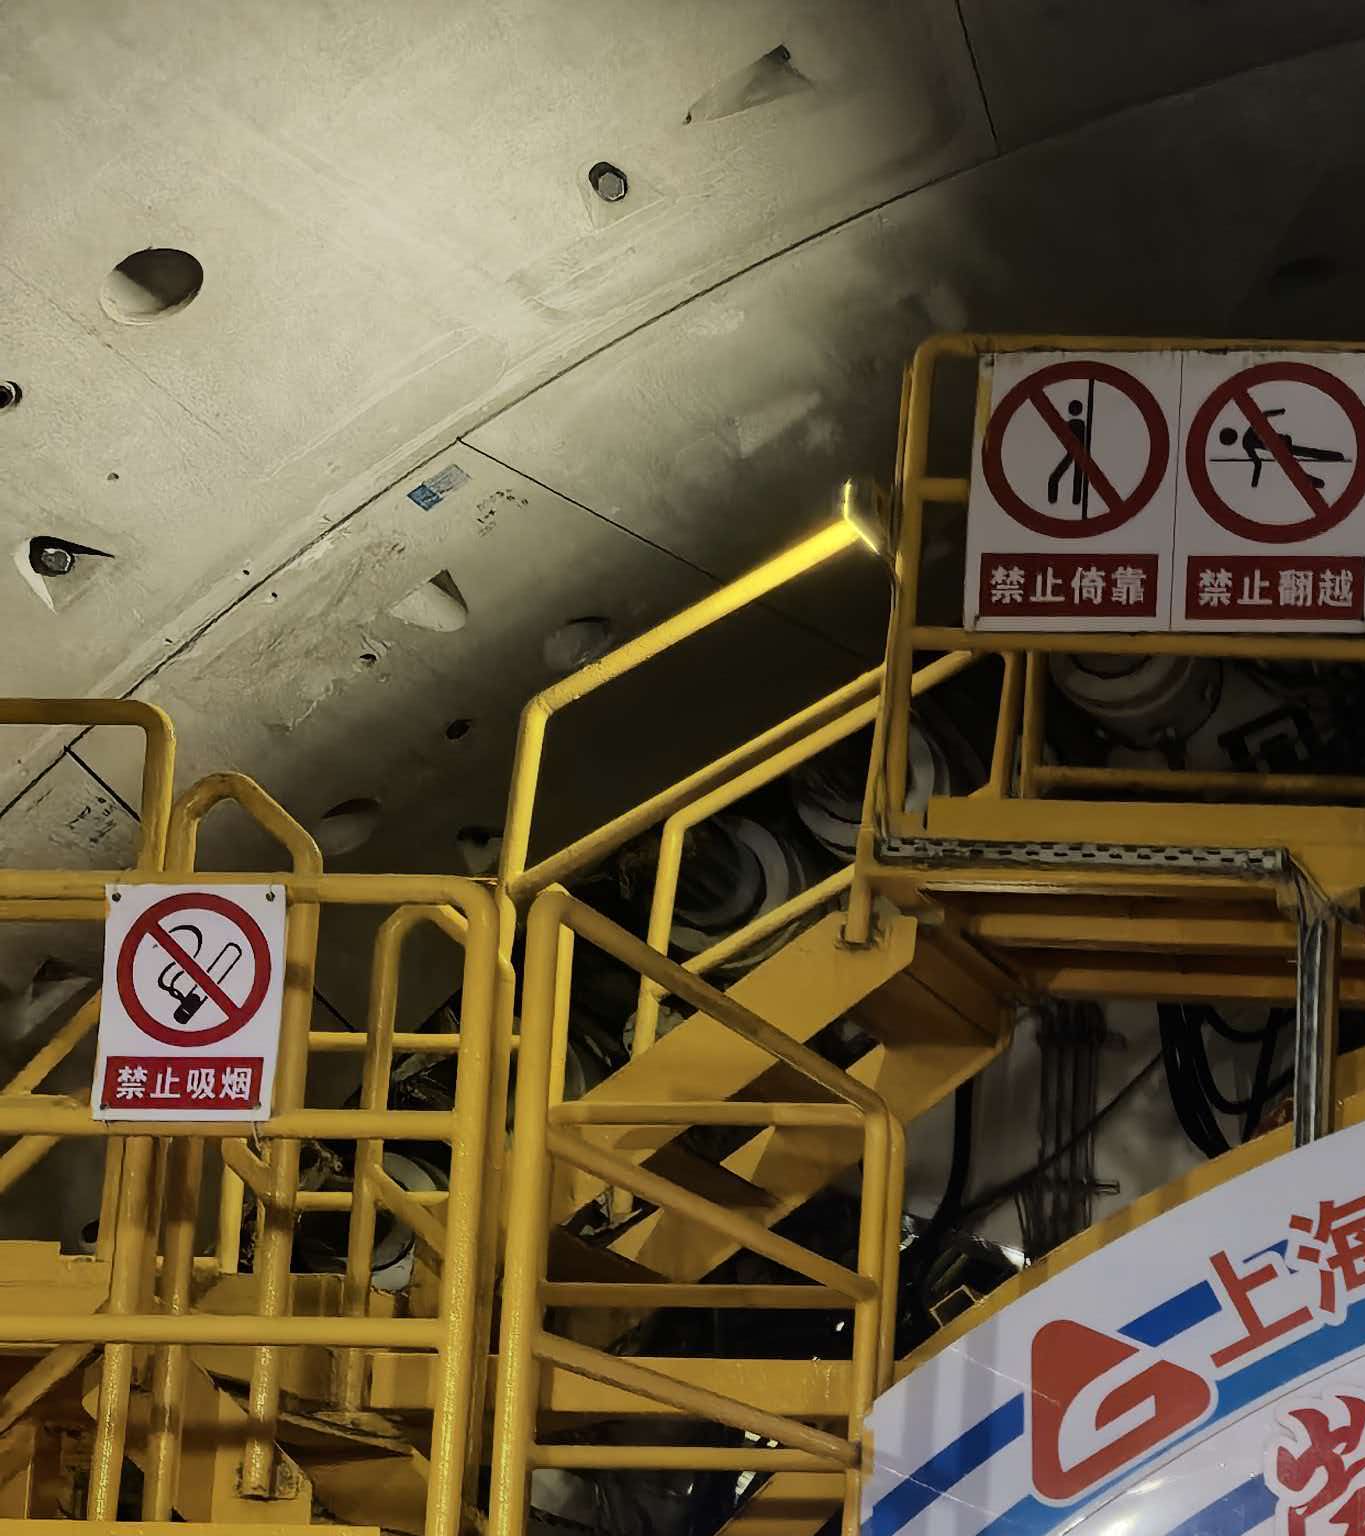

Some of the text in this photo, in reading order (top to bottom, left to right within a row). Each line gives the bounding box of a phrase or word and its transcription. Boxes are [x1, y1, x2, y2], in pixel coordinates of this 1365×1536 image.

[989, 566, 1148, 606] 禁止倚靠
[1197, 568, 1354, 608] 禁止翻越
[116, 1066, 252, 1100] 禁止吸烟
